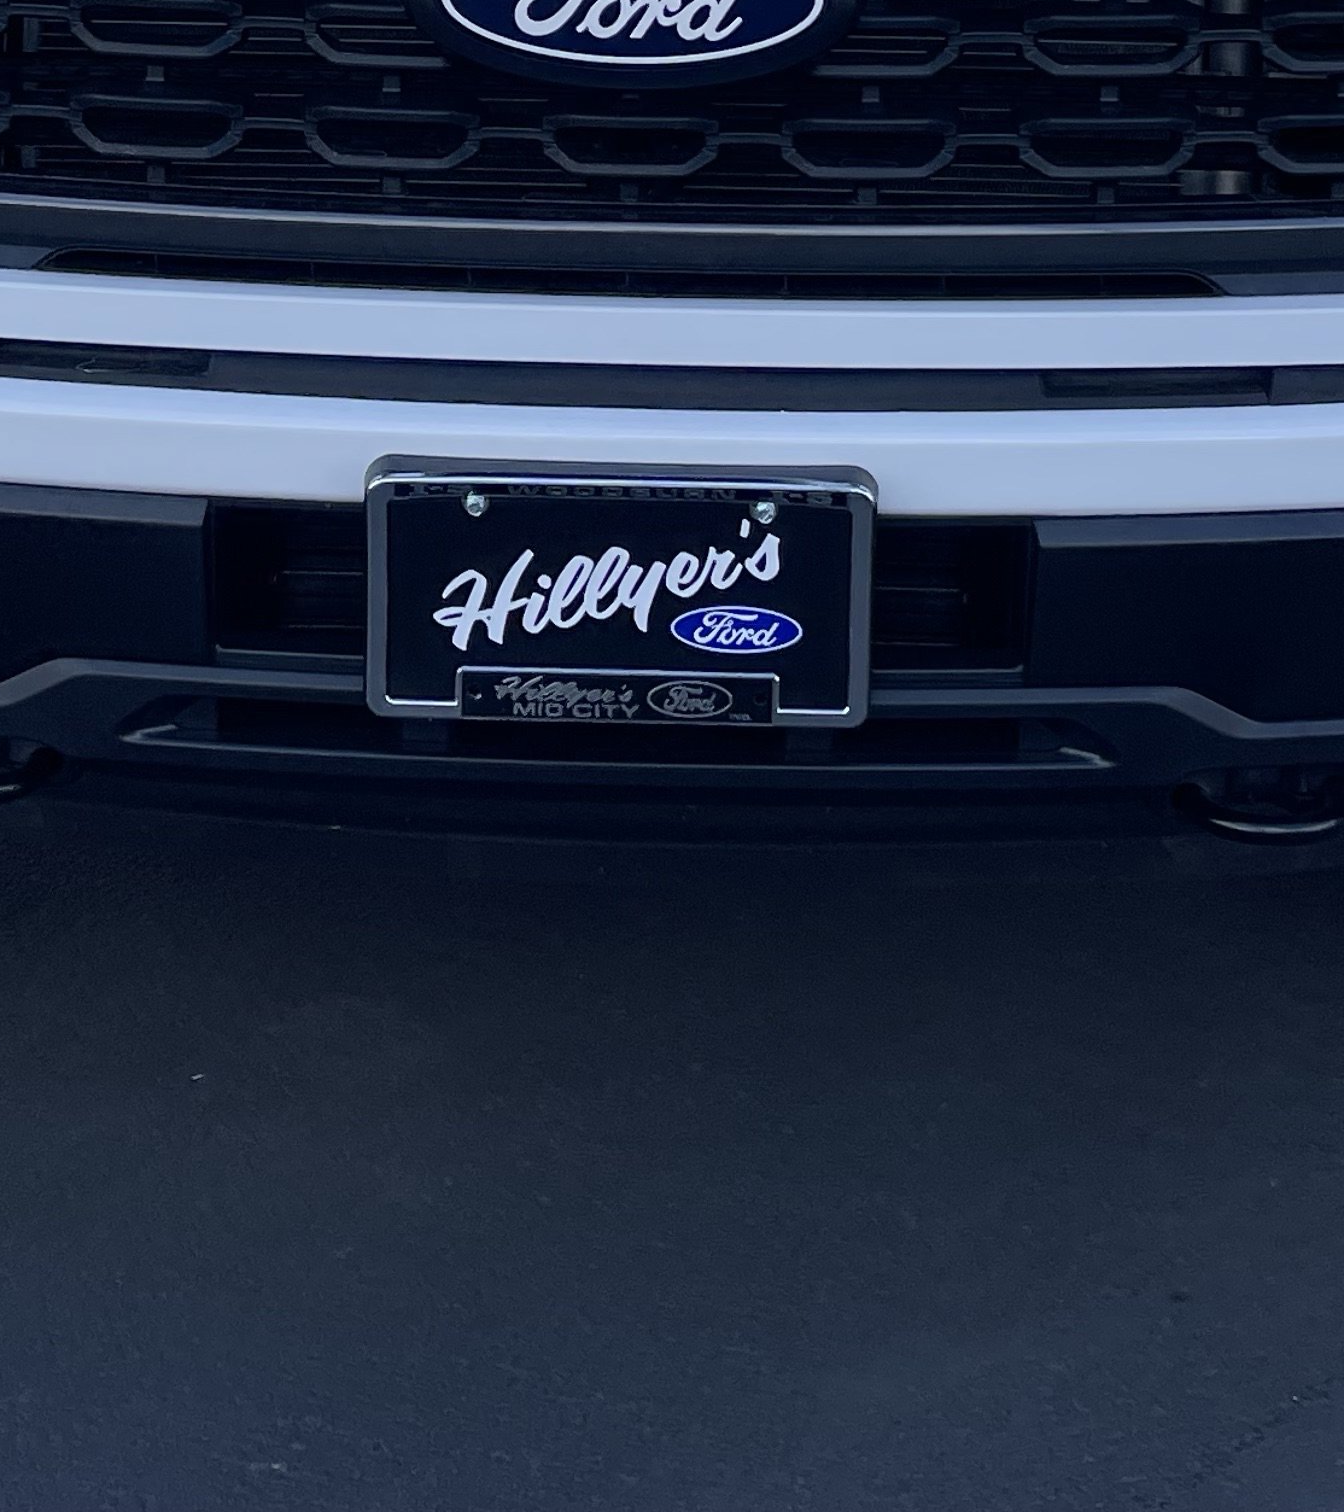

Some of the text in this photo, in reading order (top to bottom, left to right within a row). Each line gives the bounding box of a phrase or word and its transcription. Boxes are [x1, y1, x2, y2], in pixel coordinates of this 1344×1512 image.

[507, 485, 736, 500] WOODBURN
[433, 518, 781, 651] Hillyer's
[691, 611, 780, 648] Ford
[493, 674, 716, 714] Hillyer's Ford
[513, 701, 641, 719] MID CITY
